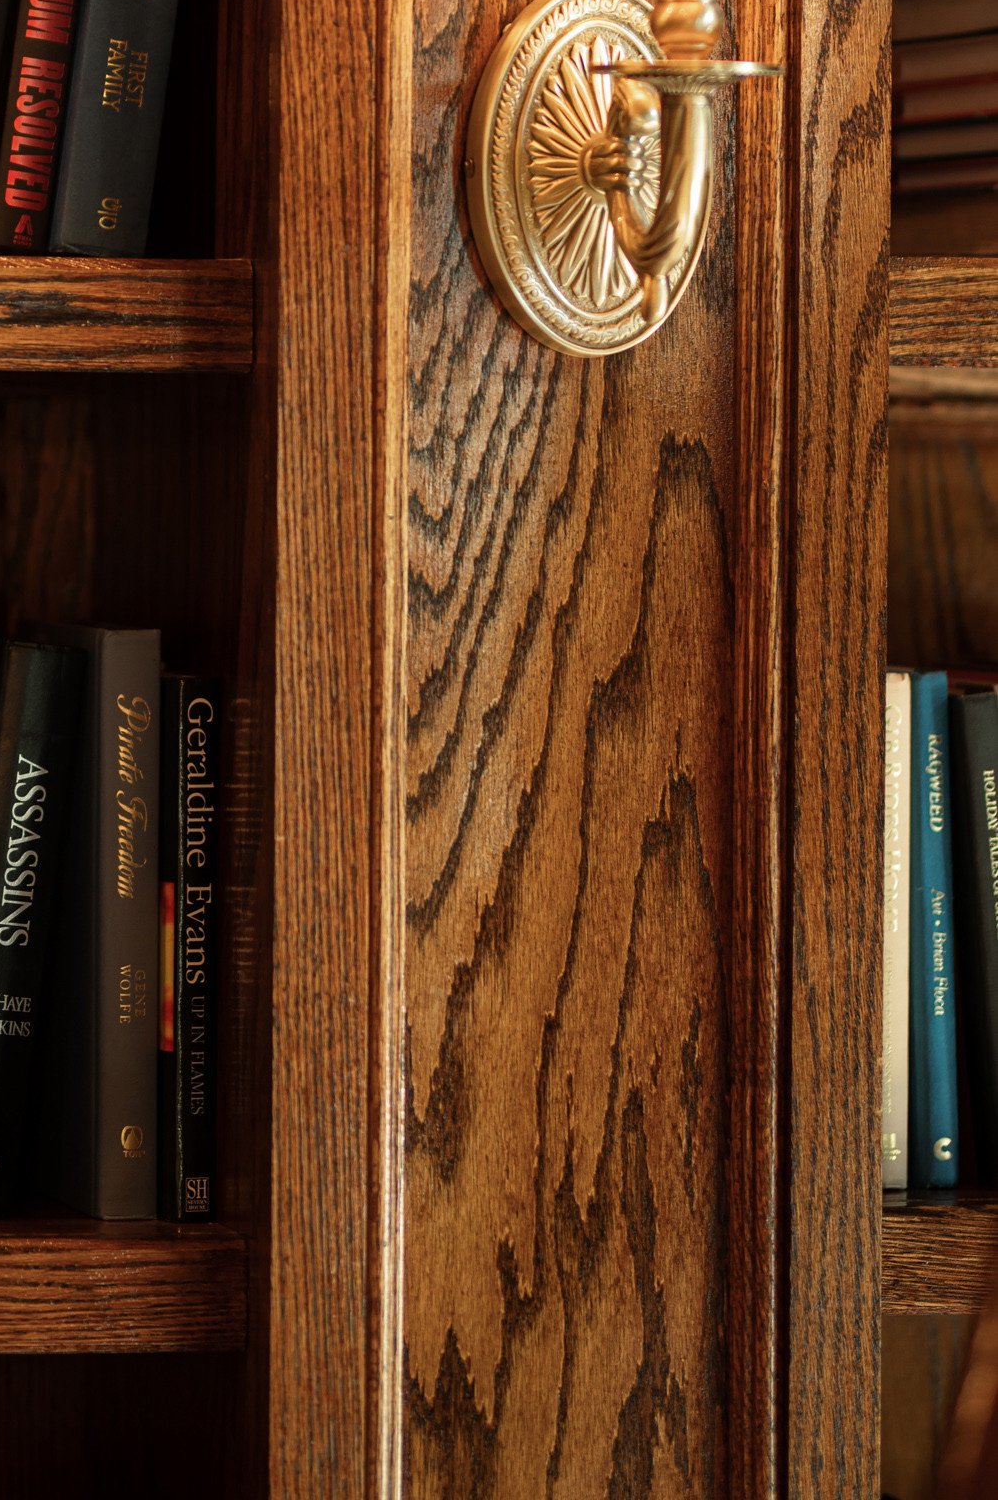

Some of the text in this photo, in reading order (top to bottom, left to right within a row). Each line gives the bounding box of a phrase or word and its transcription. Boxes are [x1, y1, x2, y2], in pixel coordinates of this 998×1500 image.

[101, 37, 129, 114] FAMILY
[124, 49, 150, 110] FIRST
[4, 56, 66, 213] RESOLVED
[115, 693, 151, 901] Pirate Freedom
[925, 733, 945, 834] RAGWEED
[982, 769, 996, 831] HOLIDAY
[184, 695, 215, 1117] Geraldine Evans UP IN FLAMES
[931, 887, 945, 916] Avi
[117, 963, 131, 1025] WOLFE
[133, 969, 146, 1018] GENE
[932, 931, 949, 1017] Brian Floca
[186, 1178, 208, 1200] SH
